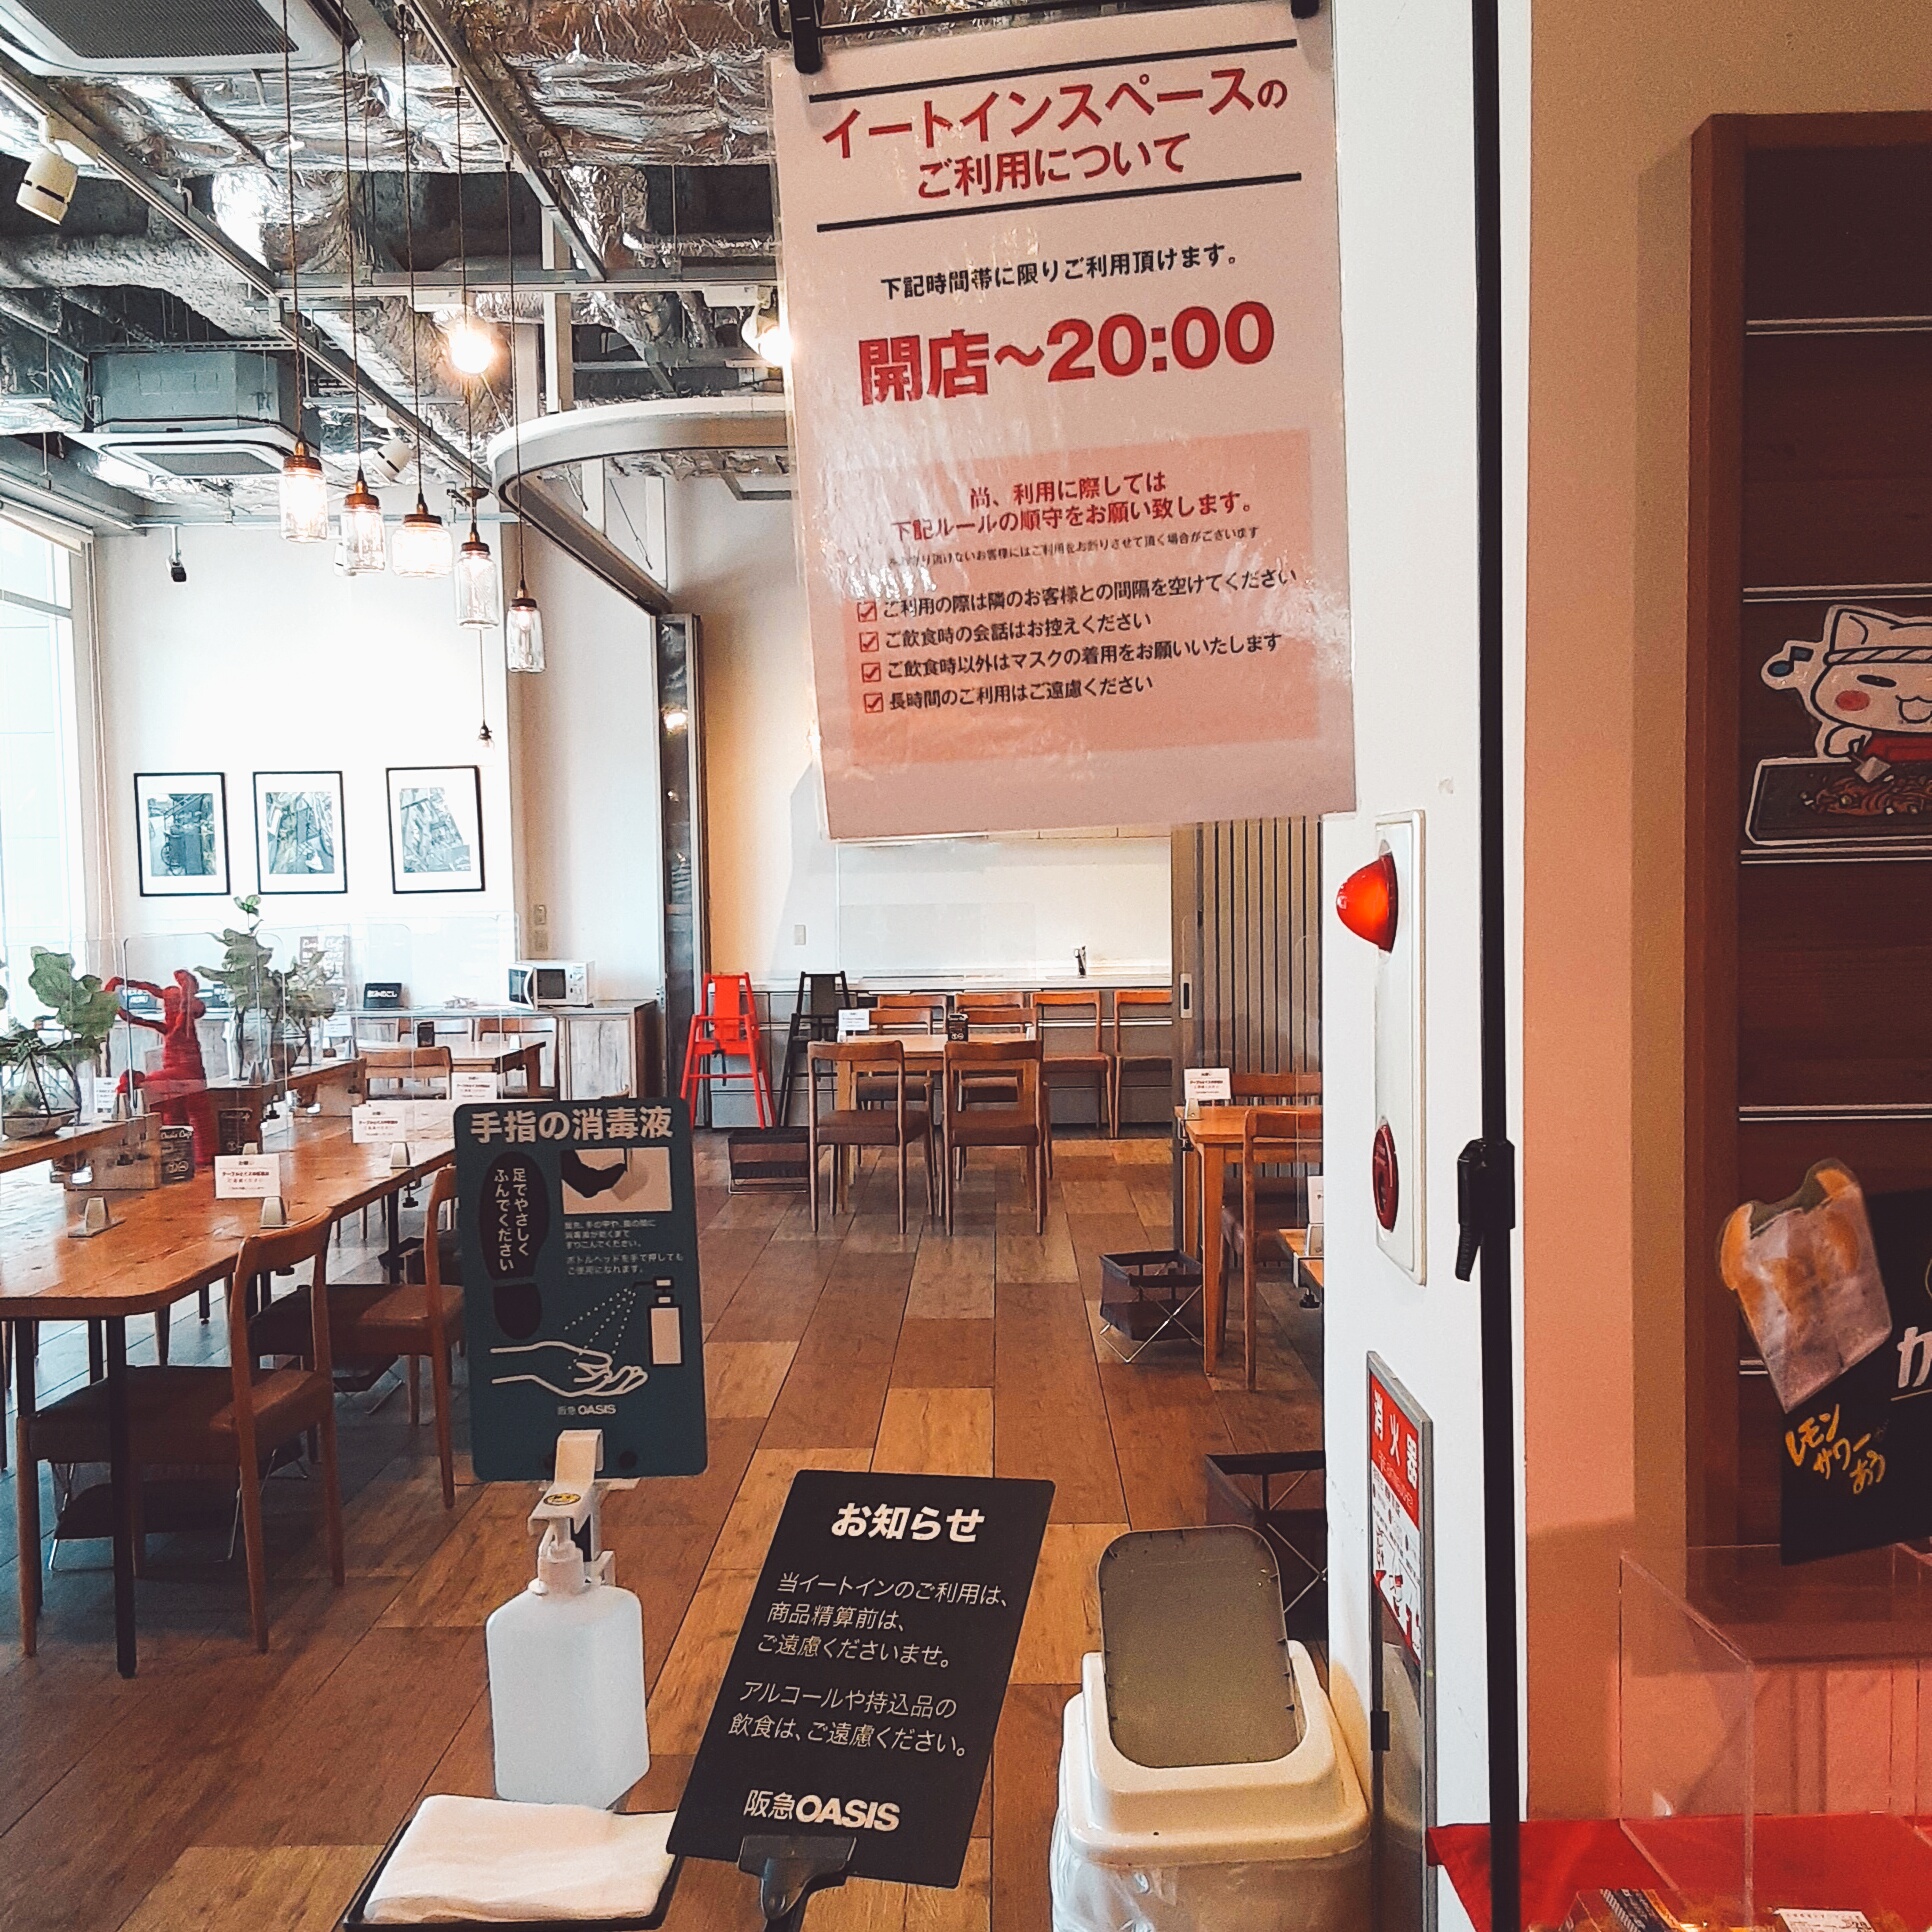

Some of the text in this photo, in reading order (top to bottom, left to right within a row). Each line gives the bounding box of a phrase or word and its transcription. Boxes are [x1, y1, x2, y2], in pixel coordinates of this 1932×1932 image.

[822, 67, 1288, 158] イートインスペースの
[918, 132, 1190, 199] ご利用について
[881, 243, 1237, 300] 下記時間帯に限りご利用頂けます。
[970, 471, 1166, 510] 尚、利用に際しては
[891, 490, 1251, 542] 下記ルールの順守をお願い致します。
[883, 568, 1297, 618] ご利用の際は隣のお客様との間隔を空けてください
[885, 611, 1151, 649] ご飲食時の会話はお控えください
[887, 632, 1282, 679] ご飲食時以外はマスクの着用をお願いいたします
[889, 674, 1153, 711] 長時間のご利用はご遠慮ください
[470, 1105, 674, 1144] 手指の消毒液
[494, 1168, 514, 1272] ふんでください
[512, 1167, 530, 1257] 足でやさしく
[831, 1502, 986, 1543] お知らせ
[777, 1571, 1008, 1607] 当イートインのご利用は、
[767, 1601, 906, 1632] 商品精算前は、
[757, 1633, 951, 1668] ご遠慮くださいませ。
[739, 1680, 957, 1719] アルコールや持込品の
[728, 1712, 966, 1757] 飲食は、ご遠慮ください。
[742, 1789, 901, 1832] 阪急OASIS
